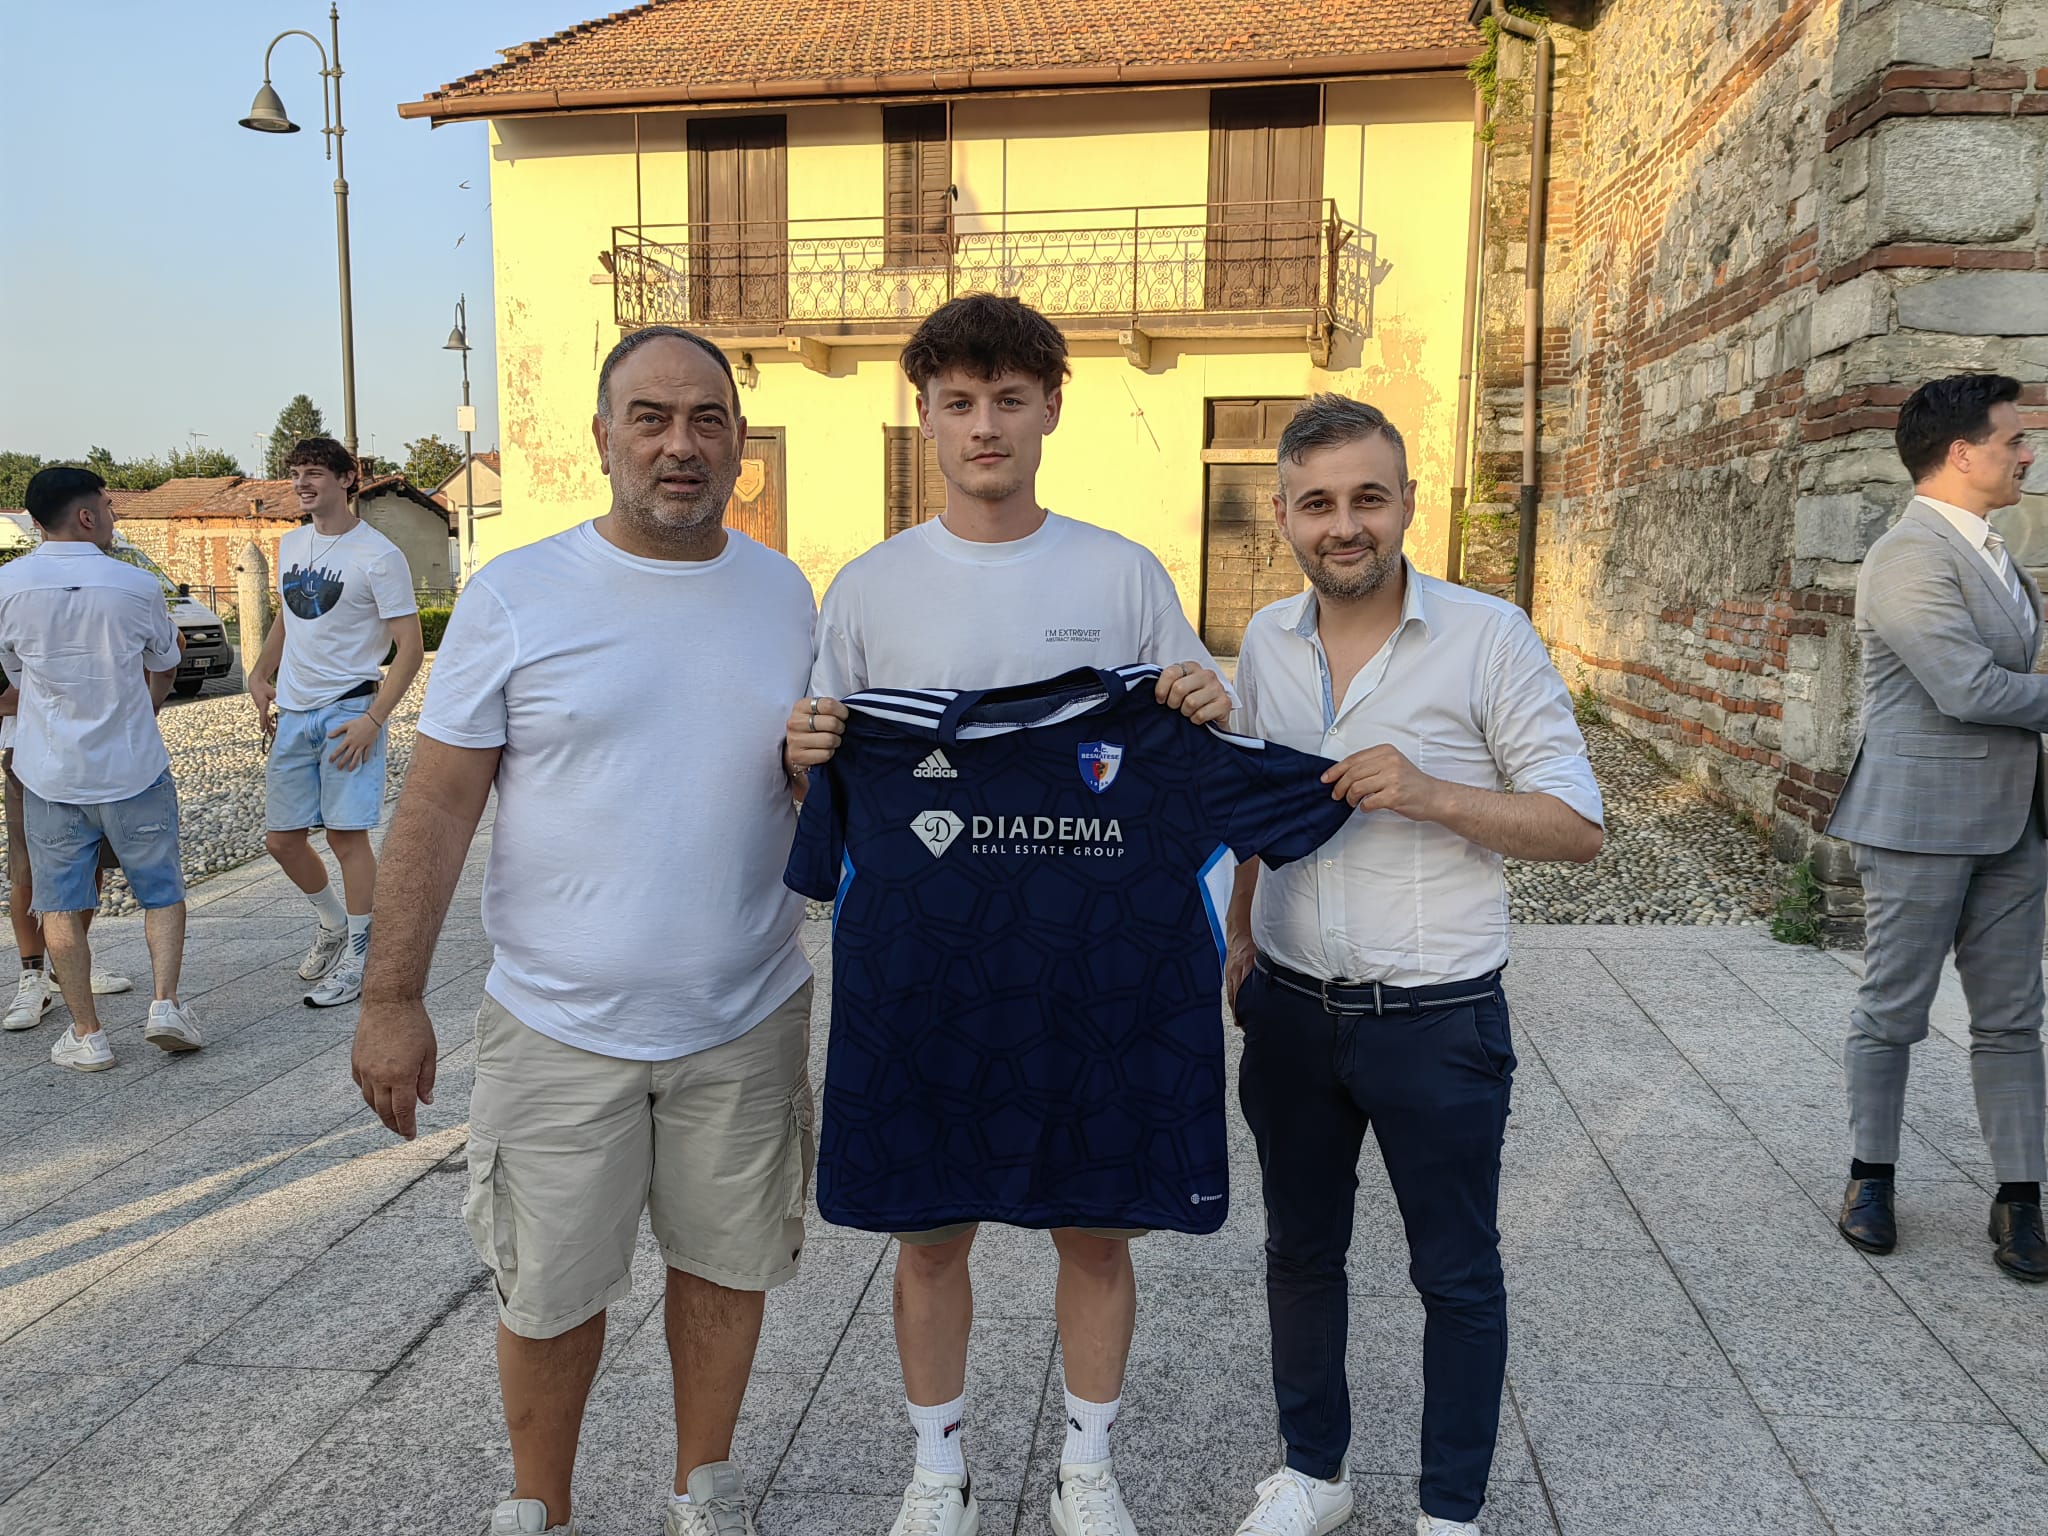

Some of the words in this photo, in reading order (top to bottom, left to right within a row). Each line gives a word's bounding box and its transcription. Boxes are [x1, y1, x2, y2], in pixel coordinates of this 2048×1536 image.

[912, 767, 958, 778] adidas
[972, 815, 1124, 842] DIADEMA
[972, 844, 1007, 855] REAL
[1015, 844, 1065, 855] ESTATE
[1073, 846, 1125, 857] GROUP
